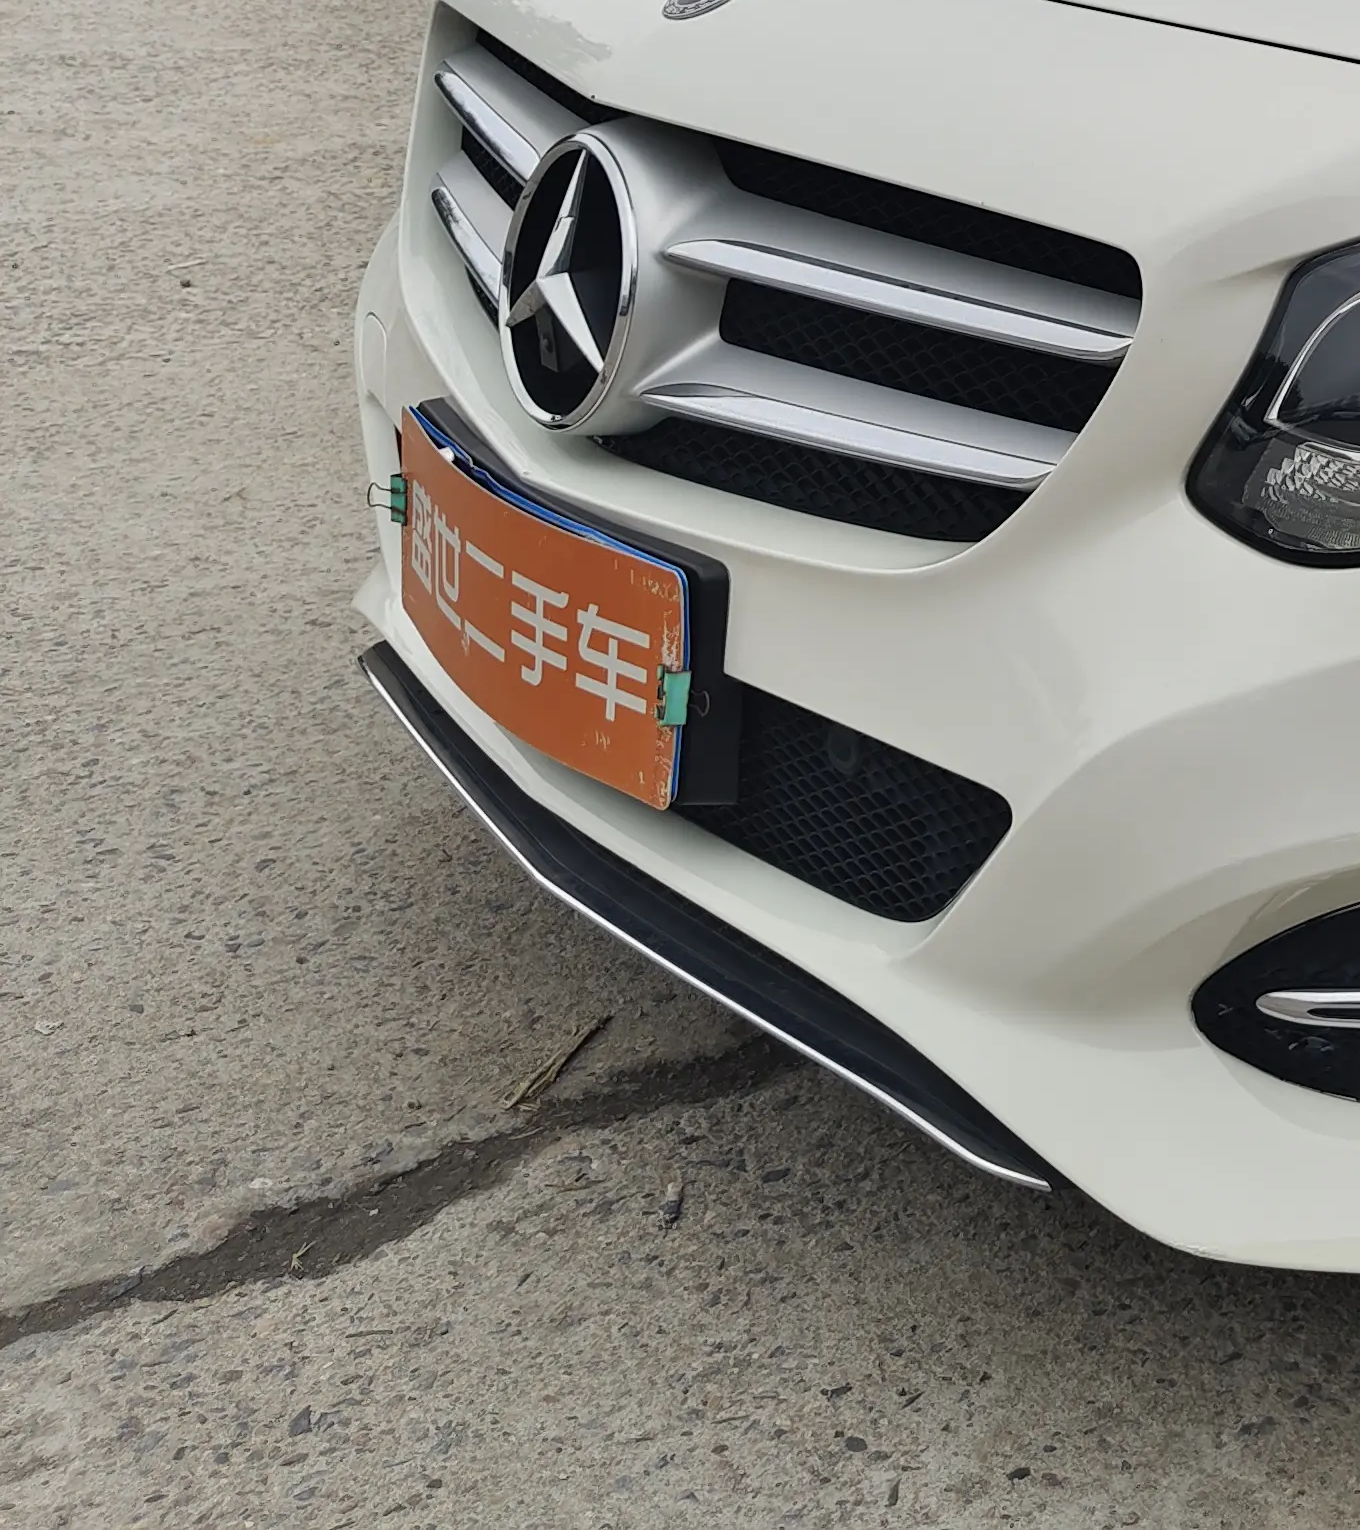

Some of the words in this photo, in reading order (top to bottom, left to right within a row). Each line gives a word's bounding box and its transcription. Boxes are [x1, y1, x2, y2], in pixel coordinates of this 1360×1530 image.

[411, 479, 651, 722] 盛世二手车
